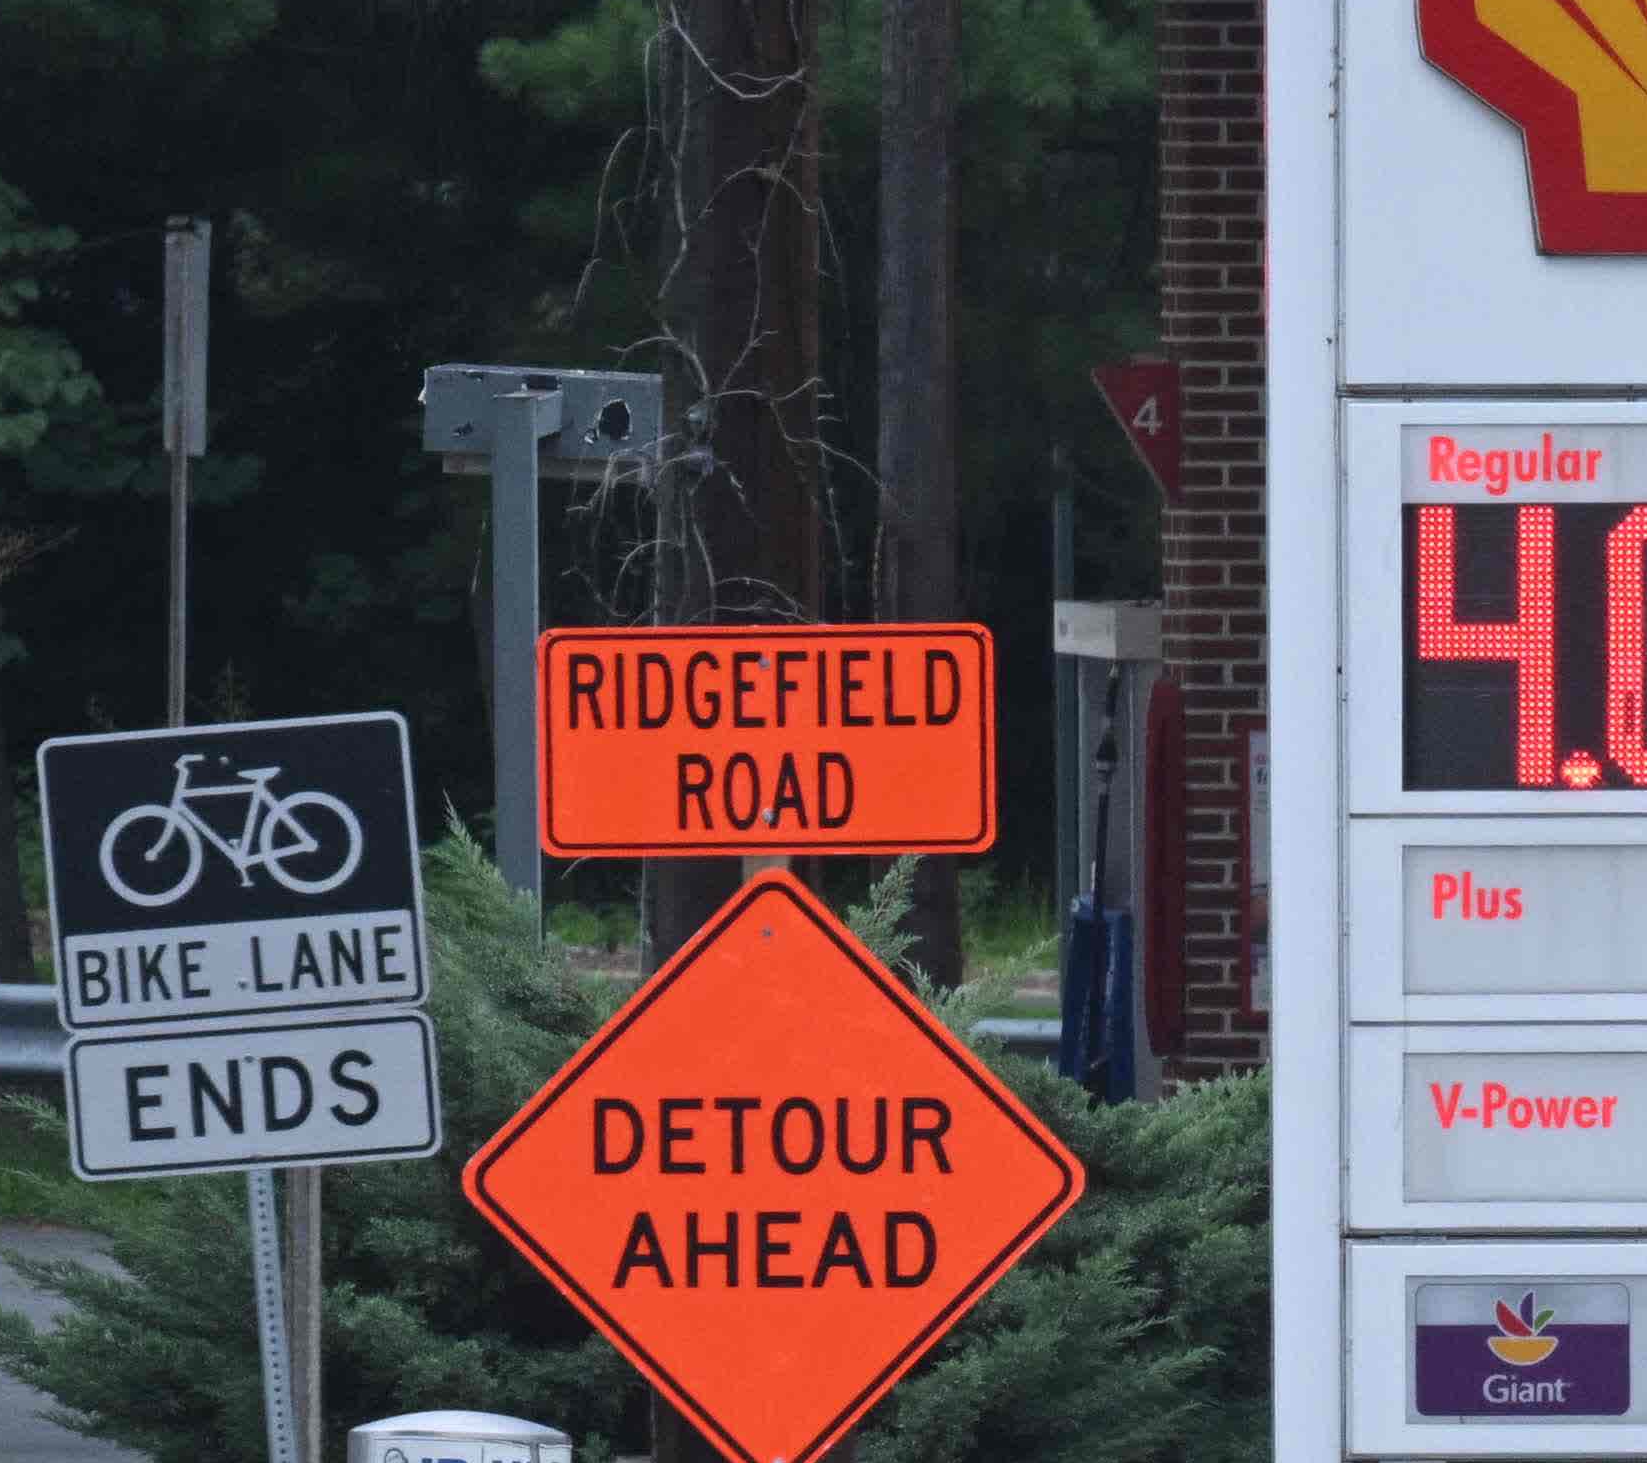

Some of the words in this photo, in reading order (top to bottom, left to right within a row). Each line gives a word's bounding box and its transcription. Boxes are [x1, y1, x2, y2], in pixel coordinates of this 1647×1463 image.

[1132, 395, 1162, 436] 4
[1428, 433, 1602, 495] Regular
[567, 649, 963, 730] RIDGEFIELD
[676, 752, 855, 831] ROAD
[1431, 873, 1524, 920] Plus
[76, 940, 211, 1008] BIKE
[251, 924, 407, 994] LANE
[124, 1048, 380, 1142] ENDS
[1430, 1081, 1618, 1131] V-Power
[592, 1096, 953, 1176] DETOUR
[612, 1210, 937, 1289] AHEAD
[1482, 1373, 1566, 1406] Giant
